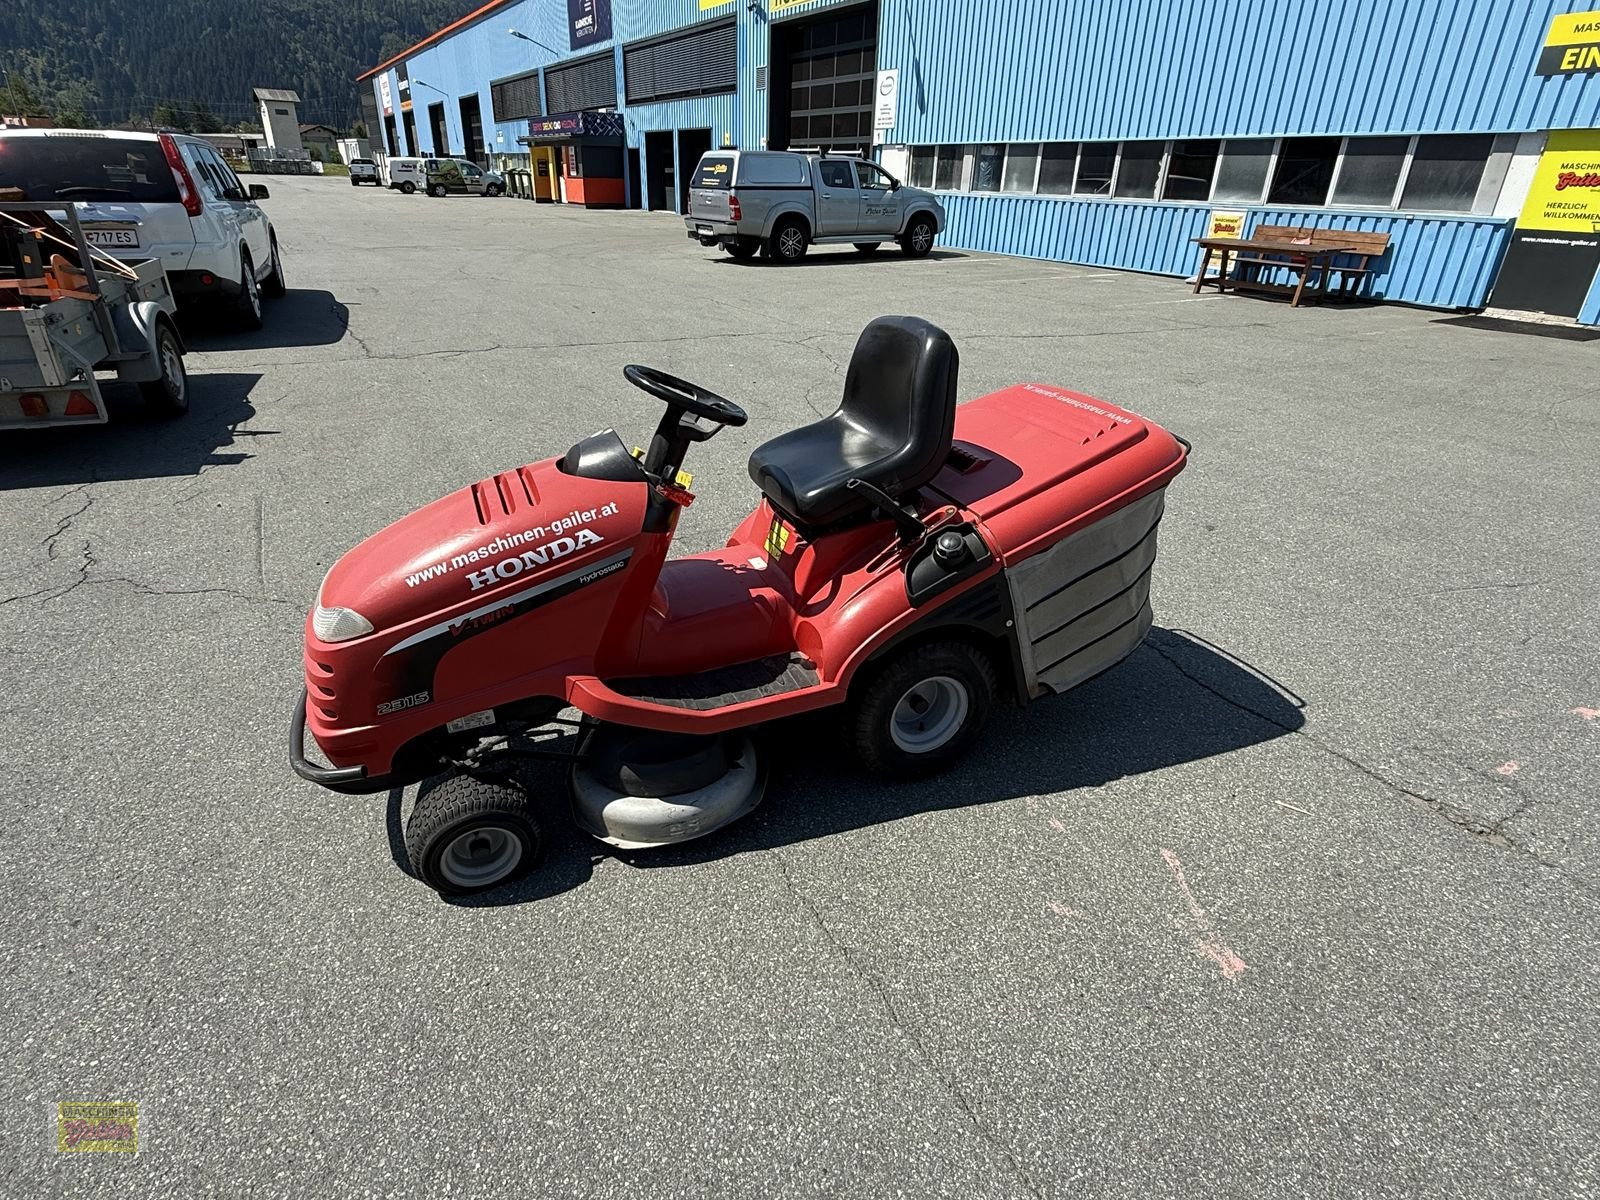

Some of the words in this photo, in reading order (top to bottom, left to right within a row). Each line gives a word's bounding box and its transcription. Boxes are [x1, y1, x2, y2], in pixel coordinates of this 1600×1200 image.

[1543, 211, 1600, 220] WILLKOMMEN
[1546, 202, 1588, 210] HERZLICH
[95, 232, 113, 243] 717
[116, 232, 132, 243] ES
[1521, 237, 1598, 247] www.maschinen-gailer.at
[404, 501, 620, 589] www.maschinen-gailer.at
[465, 528, 605, 591] HONDA
[579, 561, 625, 584] Hydrostatic
[448, 603, 517, 638] V-TWIN
[376, 691, 430, 716] 2315
